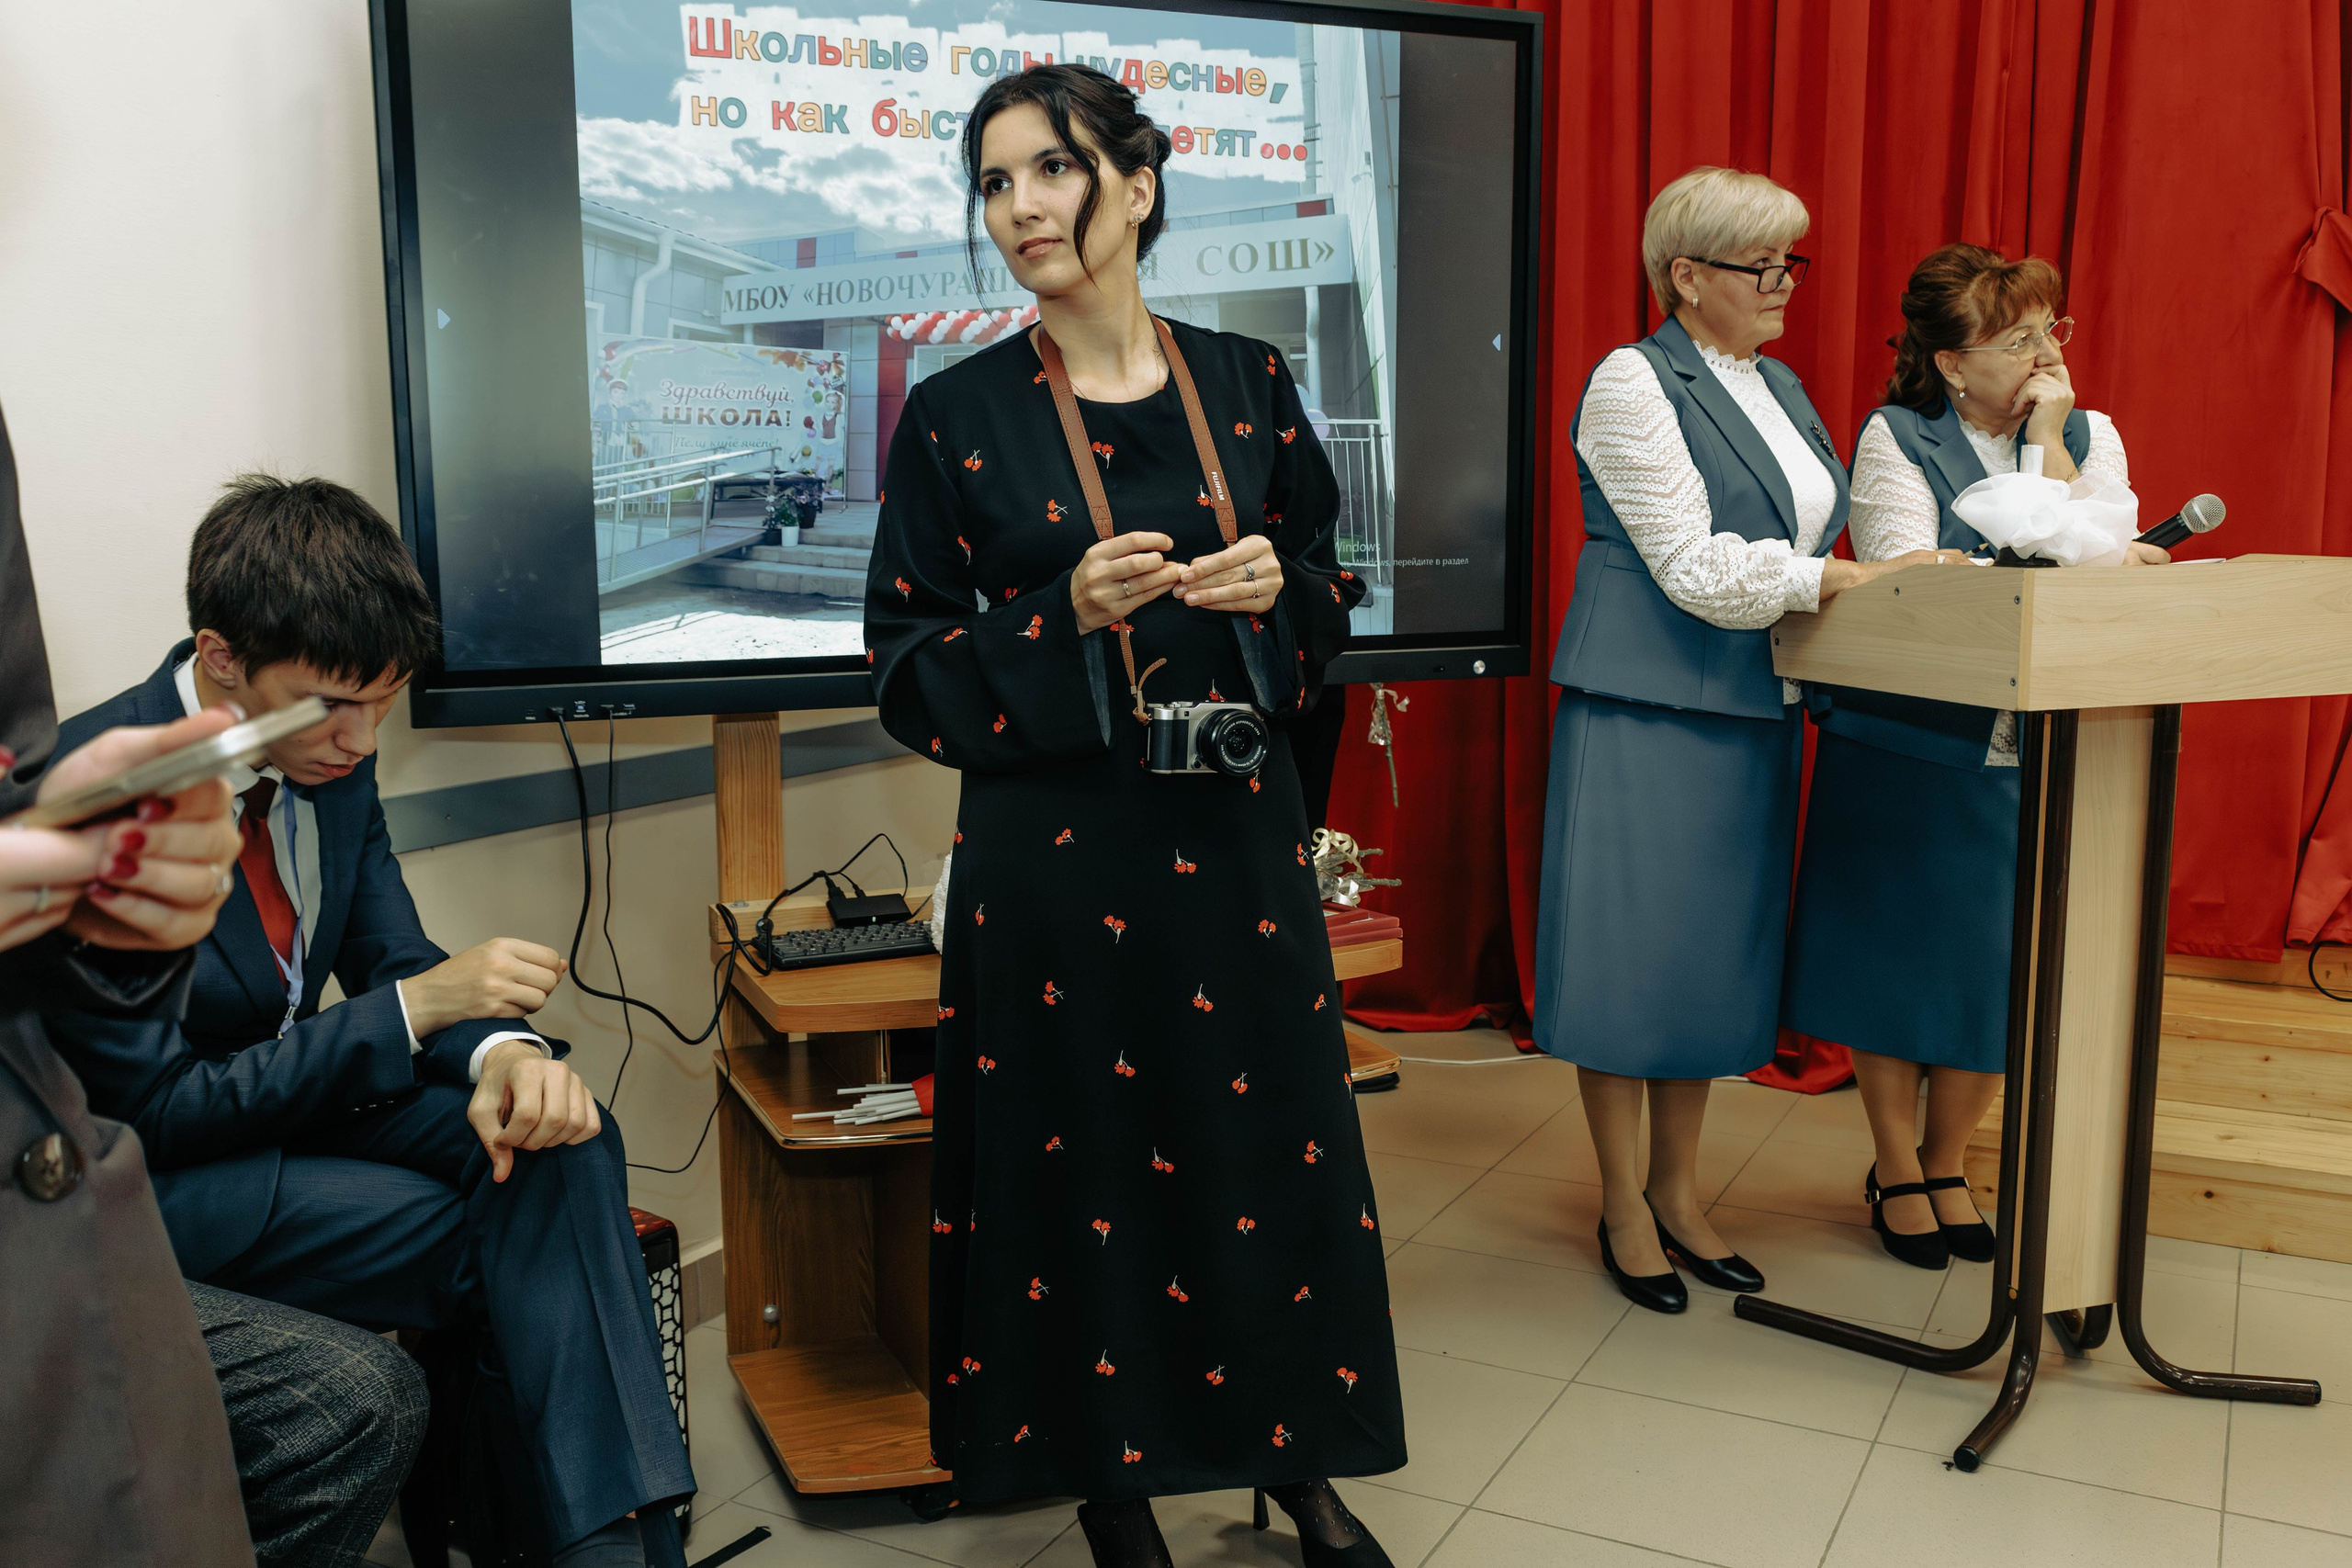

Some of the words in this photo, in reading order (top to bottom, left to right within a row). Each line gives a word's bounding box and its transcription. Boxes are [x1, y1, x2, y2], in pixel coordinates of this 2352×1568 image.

[687, 16, 929, 73] Школьные
[691, 96, 748, 129] но
[771, 100, 851, 134] как
[721, 284, 795, 313] МБОУ
[1195, 237, 1335, 276] СОШ»
[660, 379, 794, 409] Здравствуй,
[662, 406, 792, 427] ШКОЛА!
[1211, 471, 1226, 501] FUJIFILM
[1393, 557, 1434, 568] перейдите
[1442, 557, 1469, 568] раздел
